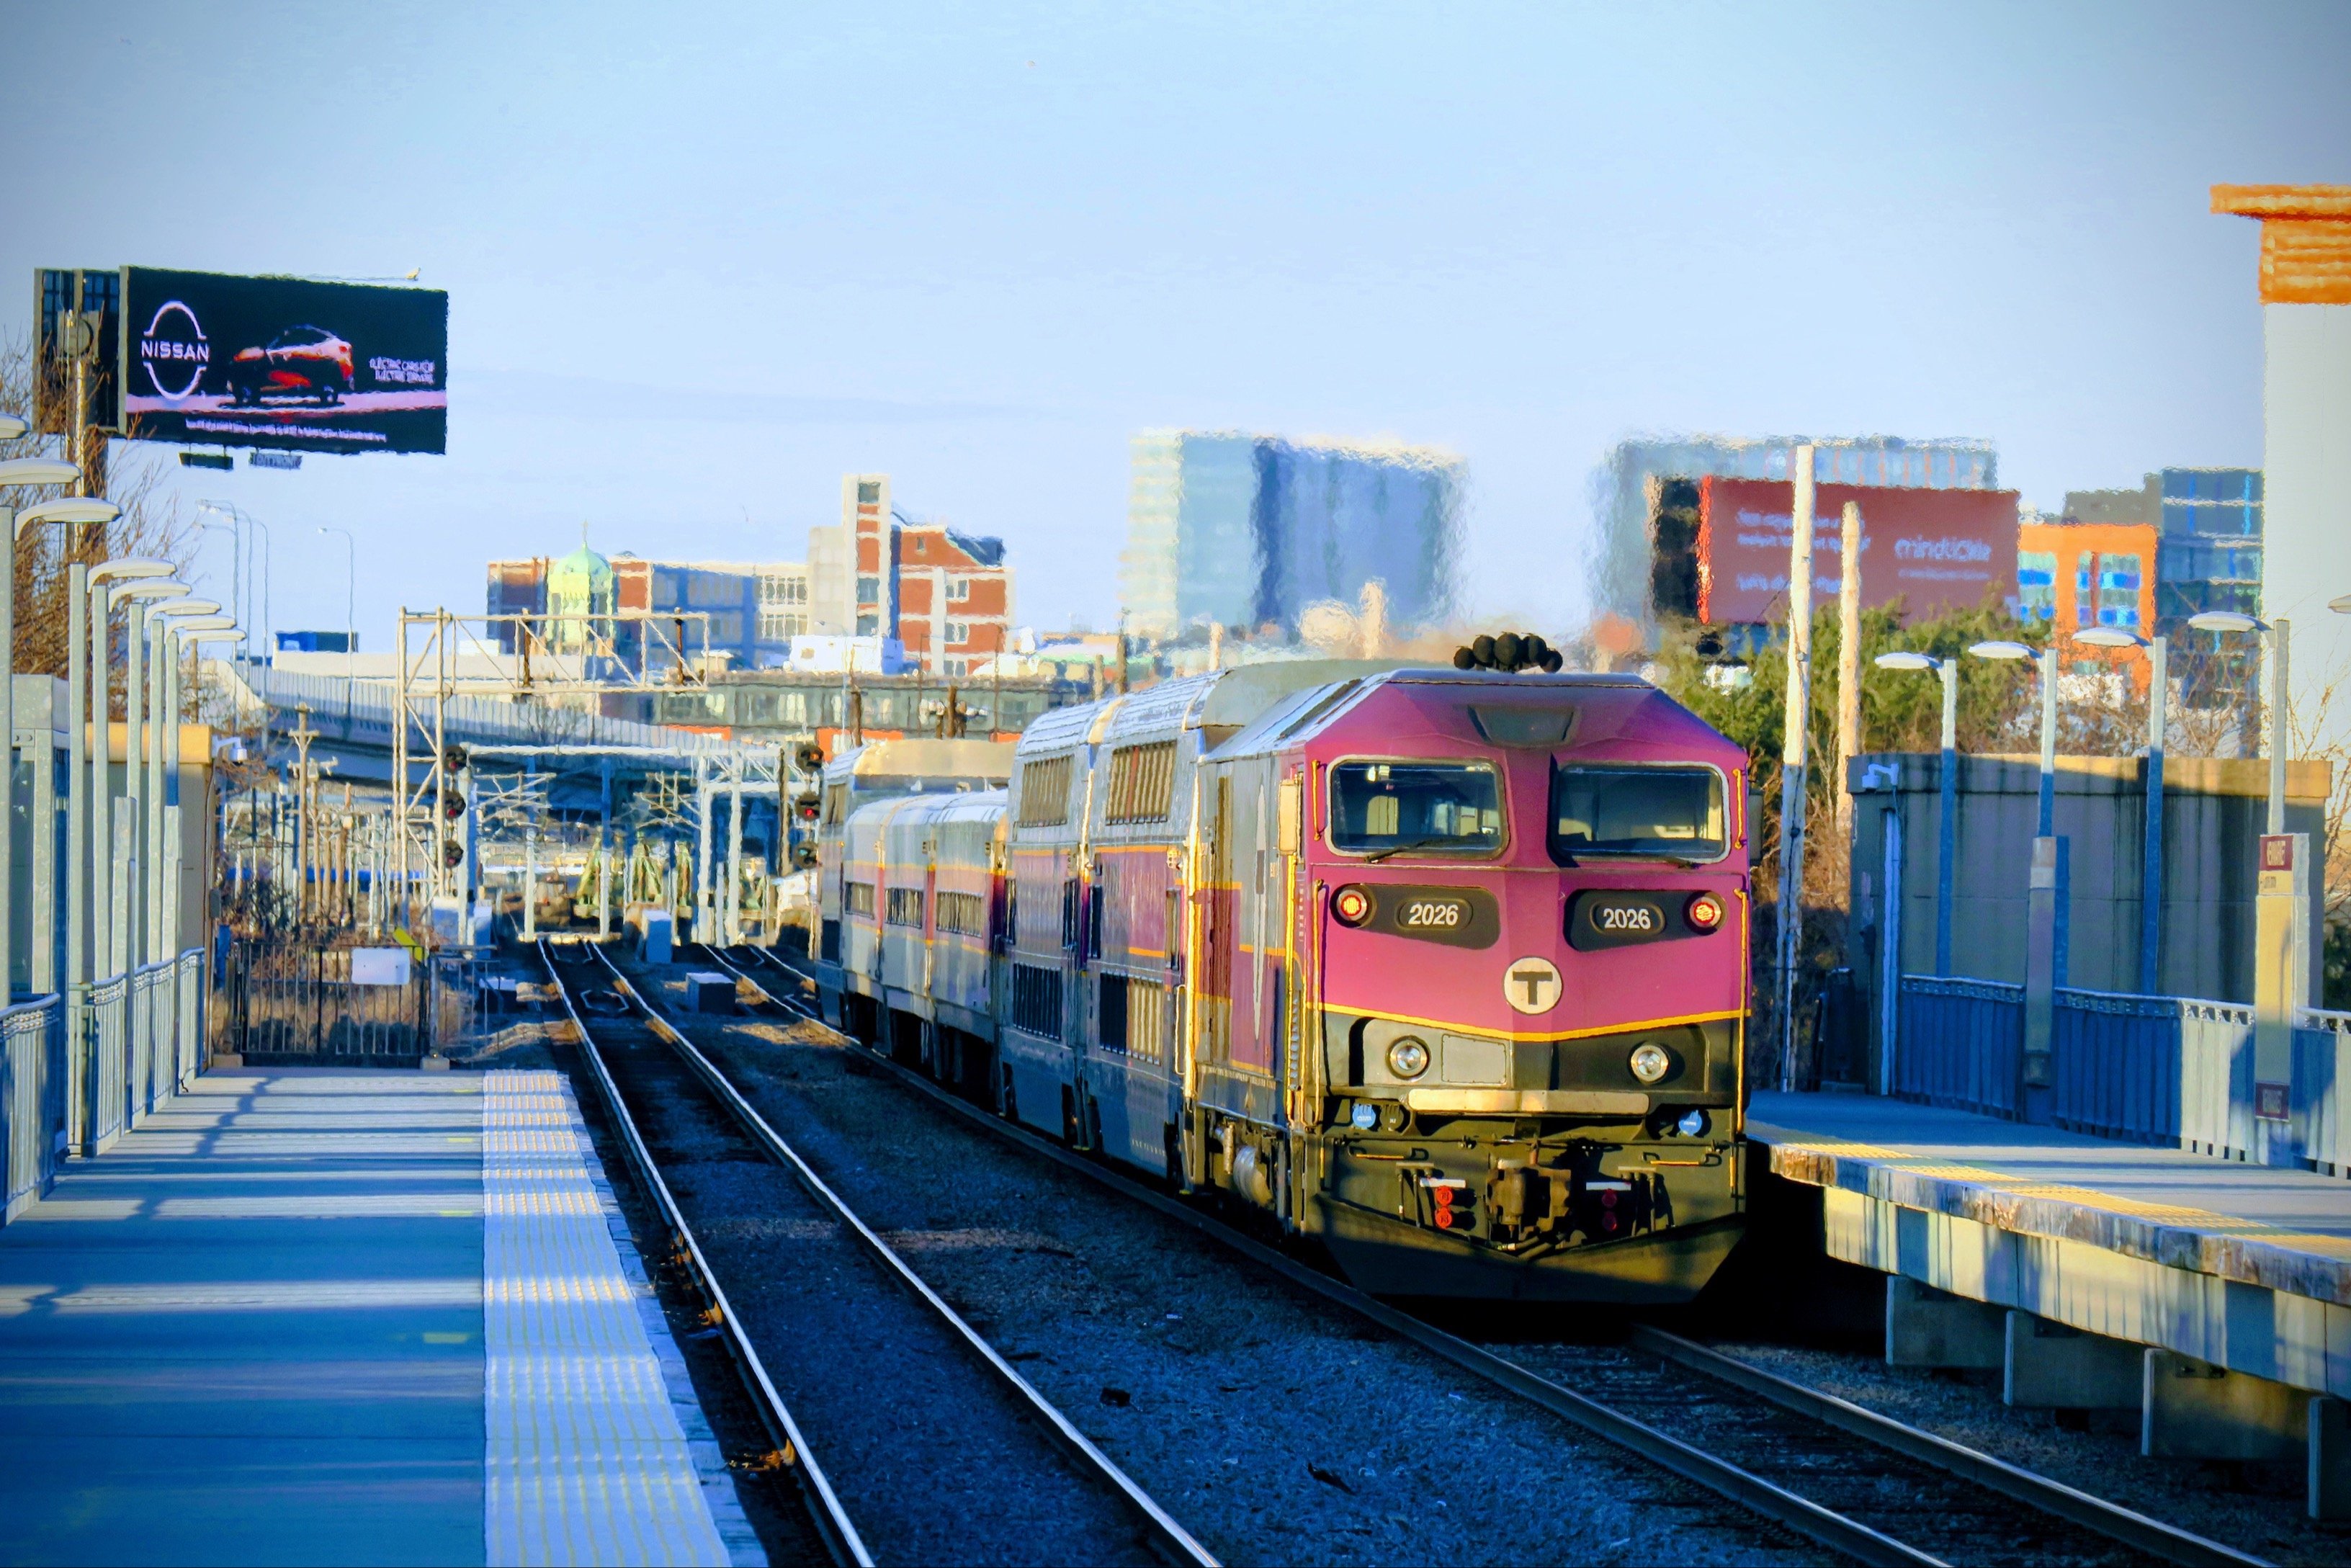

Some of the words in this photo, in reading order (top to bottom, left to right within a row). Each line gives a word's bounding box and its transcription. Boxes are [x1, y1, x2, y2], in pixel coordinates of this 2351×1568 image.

[141, 340, 209, 362] NISSAN
[1407, 903, 1459, 926] 2026
[1603, 908, 1652, 930] 2026
[1512, 971, 1554, 1005] T
